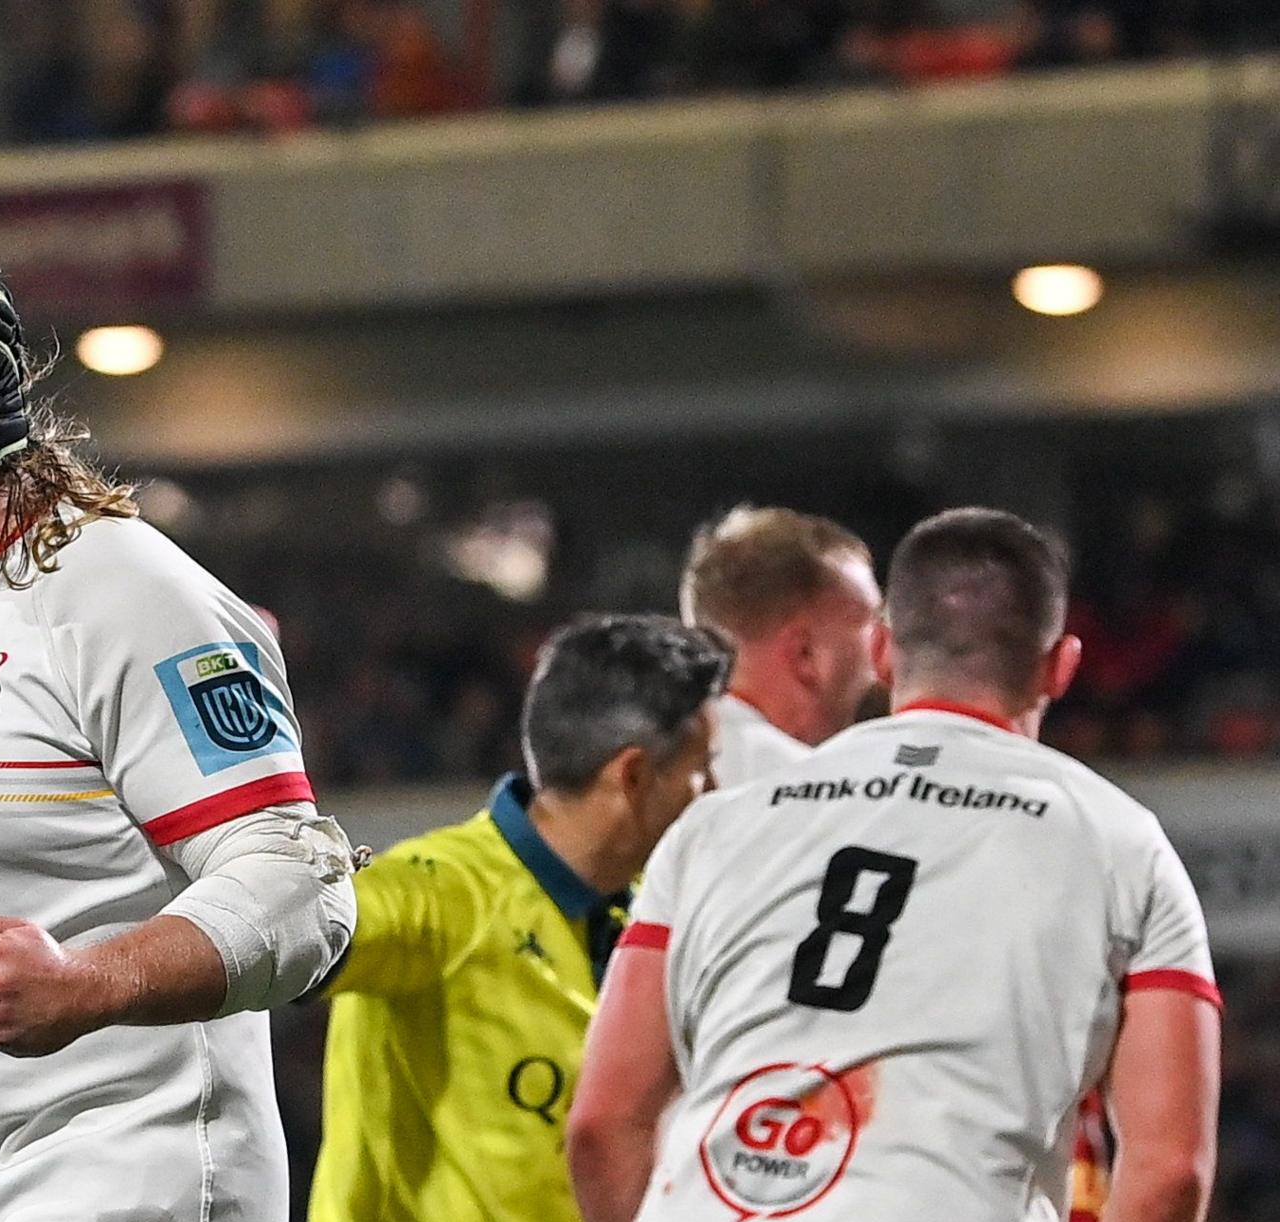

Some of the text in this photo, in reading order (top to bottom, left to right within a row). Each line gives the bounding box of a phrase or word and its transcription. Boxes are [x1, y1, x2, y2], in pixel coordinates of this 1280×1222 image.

[196, 653, 238, 676] BKT
[787, 846, 918, 1013] 8
[736, 1098, 821, 1156] Go
[733, 1152, 809, 1179] POWER
